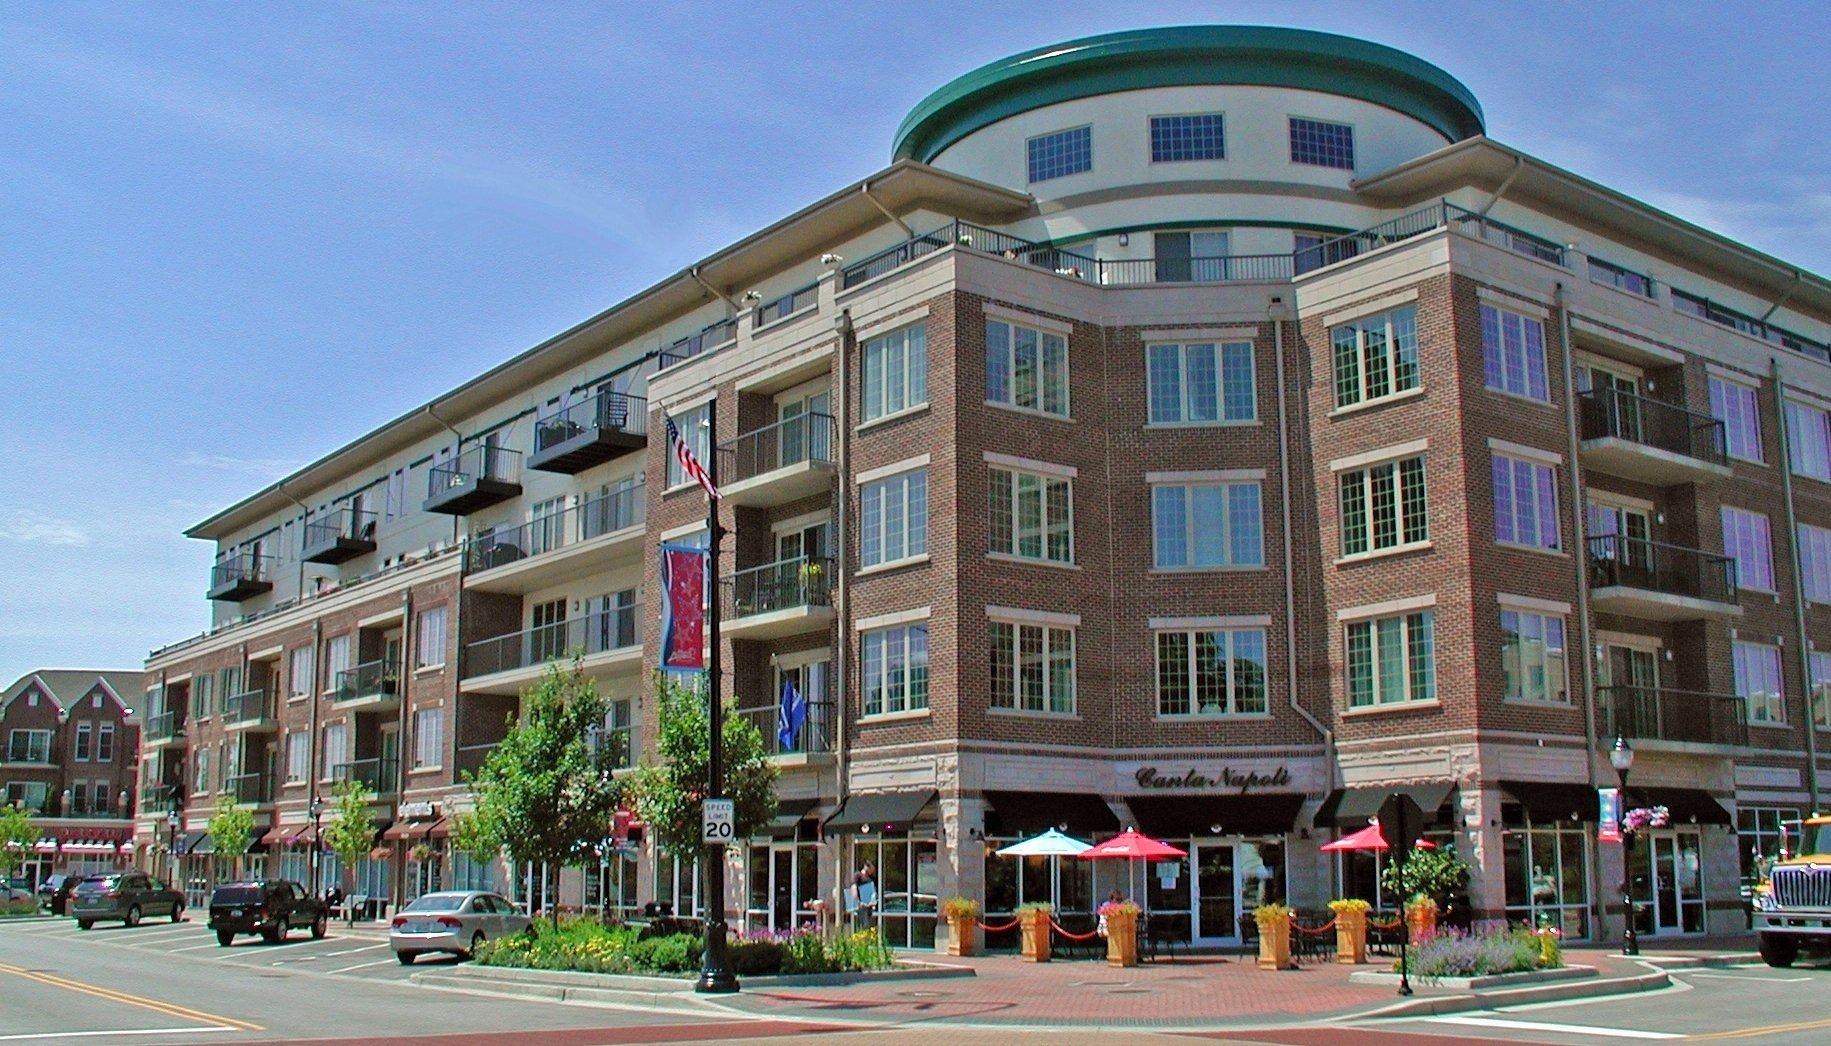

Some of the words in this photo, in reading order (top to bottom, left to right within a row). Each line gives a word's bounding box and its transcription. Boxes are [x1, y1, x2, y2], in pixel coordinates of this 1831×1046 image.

[1209, 766, 1290, 794] Napoli
[705, 803, 732, 811] SPEED
[708, 812, 729, 820] LIMIT
[706, 822, 731, 838] 20
